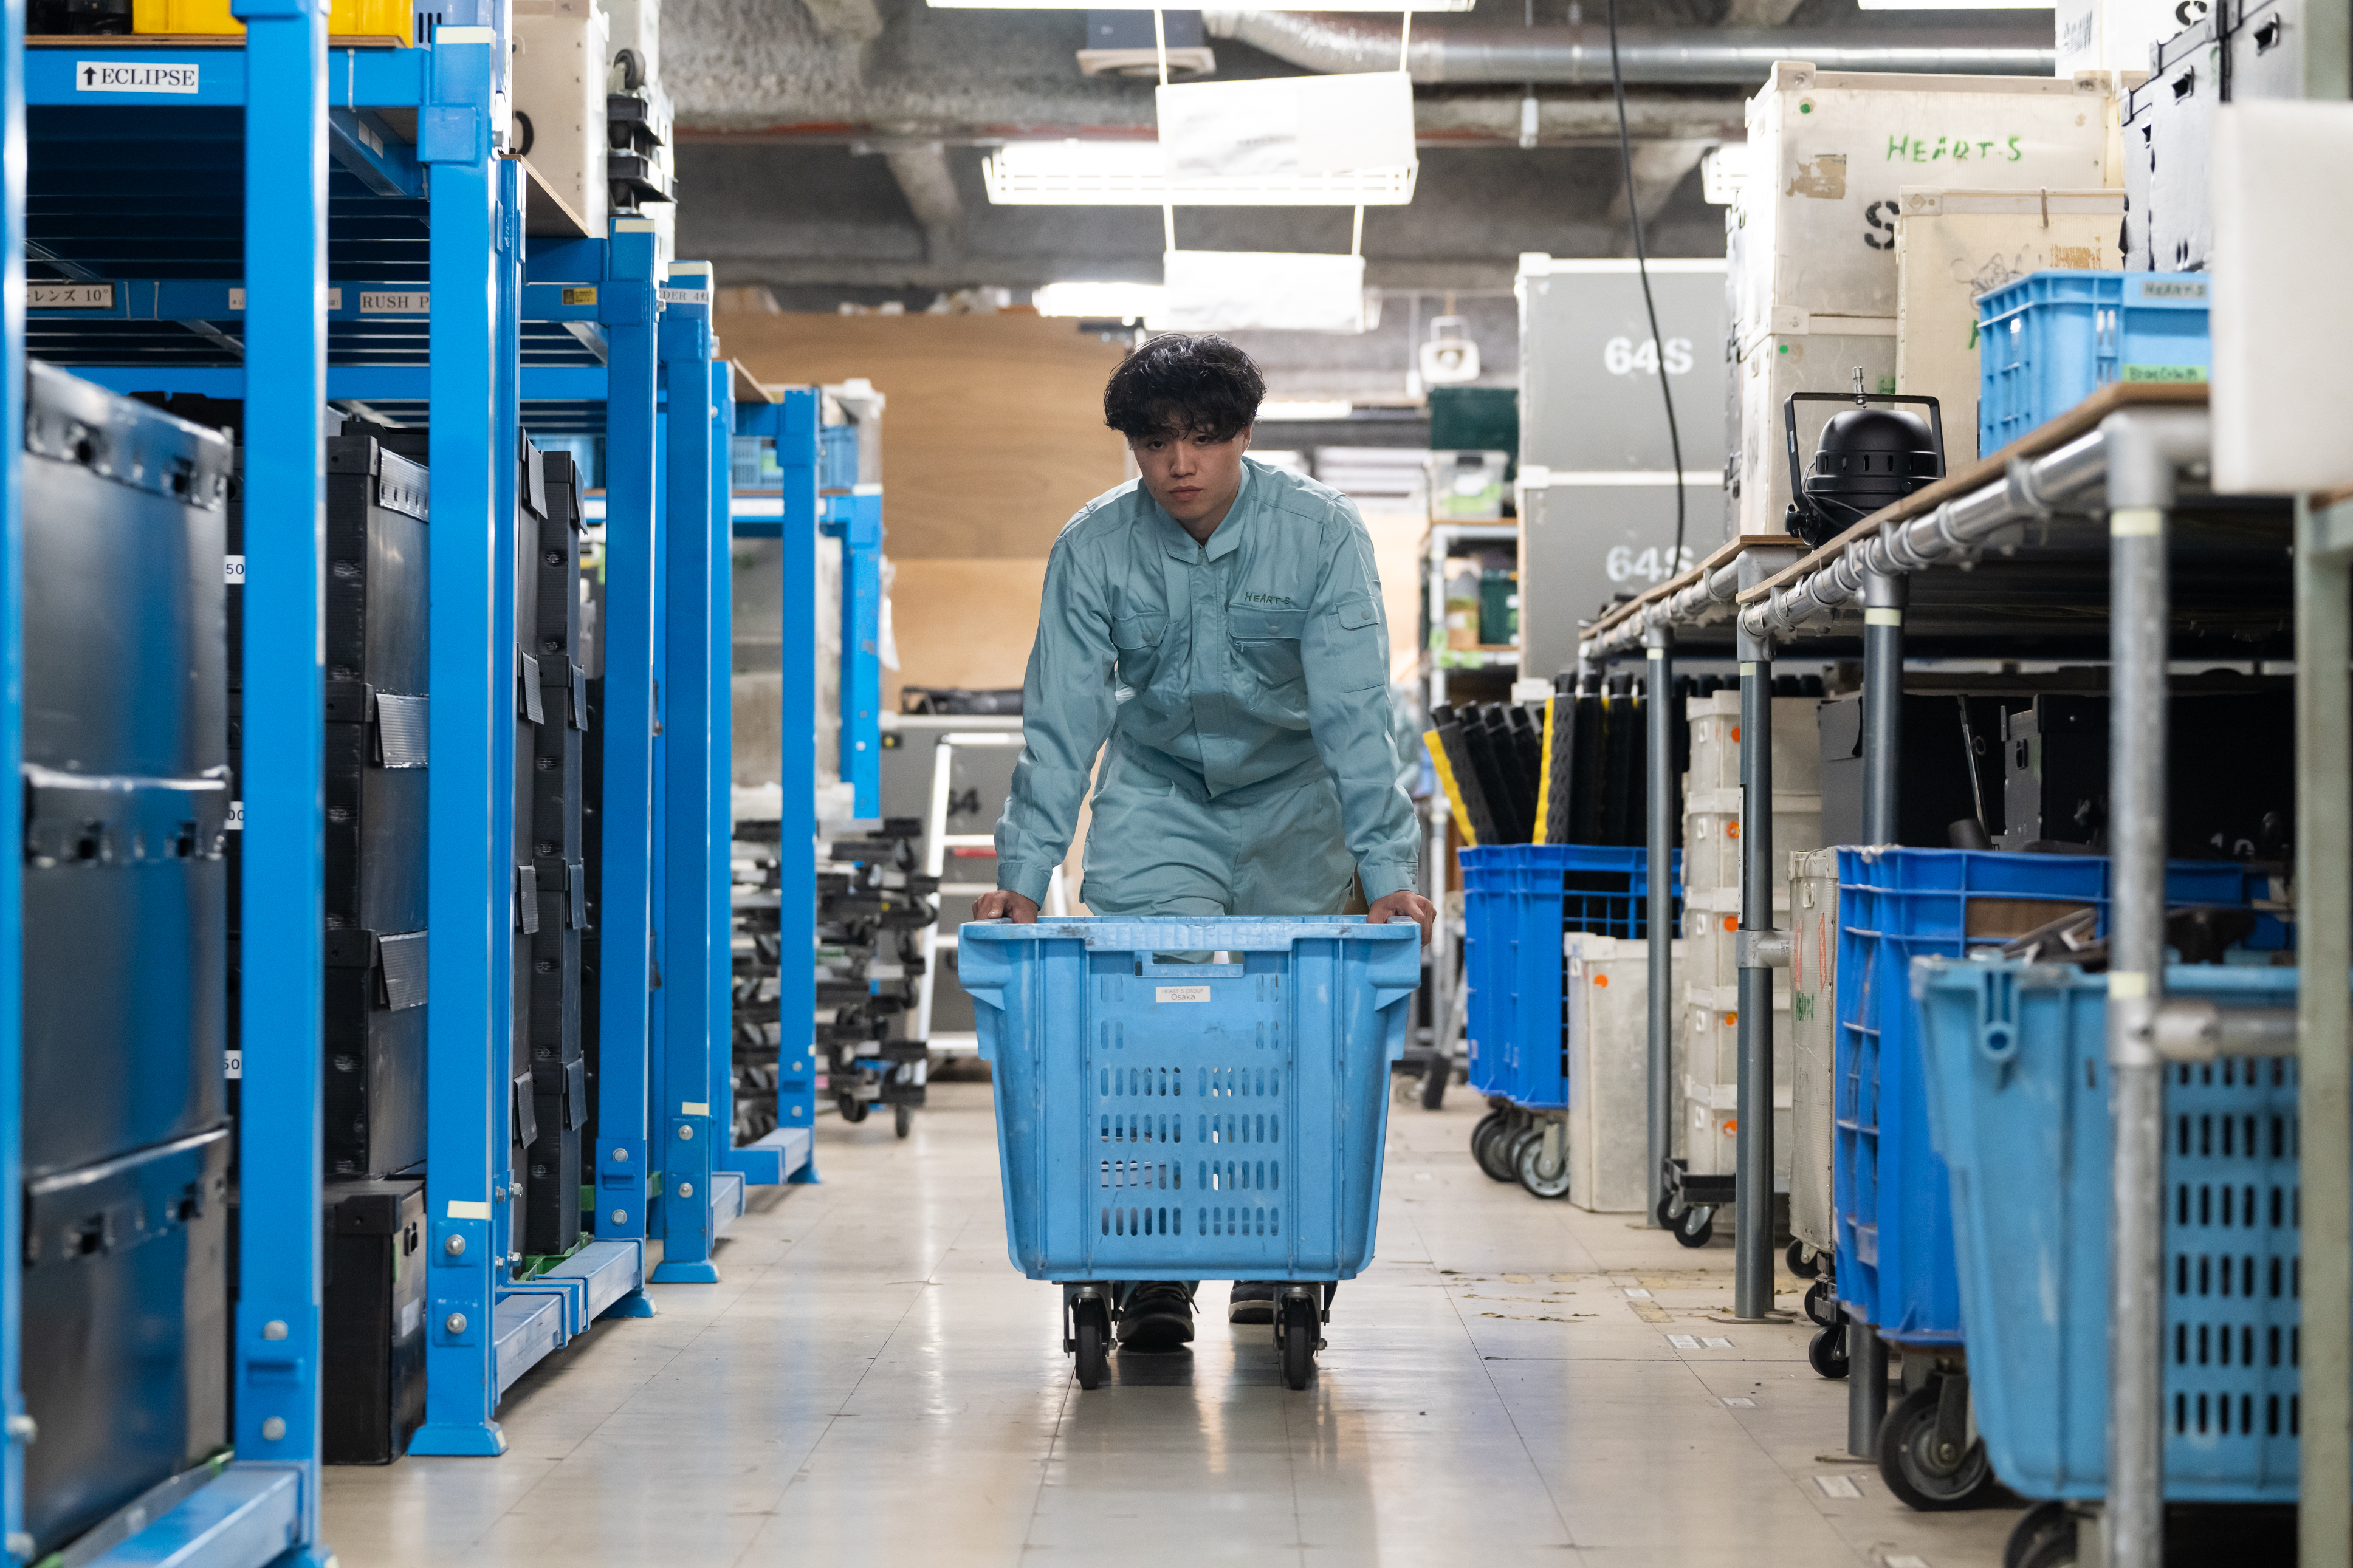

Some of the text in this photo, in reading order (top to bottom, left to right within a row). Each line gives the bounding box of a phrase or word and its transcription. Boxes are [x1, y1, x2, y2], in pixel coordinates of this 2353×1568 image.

[101, 68, 195, 86] ECLIPSE
[363, 295, 408, 309] RUSH
[659, 290, 686, 300] DER
[1604, 337, 1694, 375] 64S
[226, 563, 244, 575] 50
[1606, 546, 1694, 583] 64S
[1244, 591, 1290, 604] HEART-S
